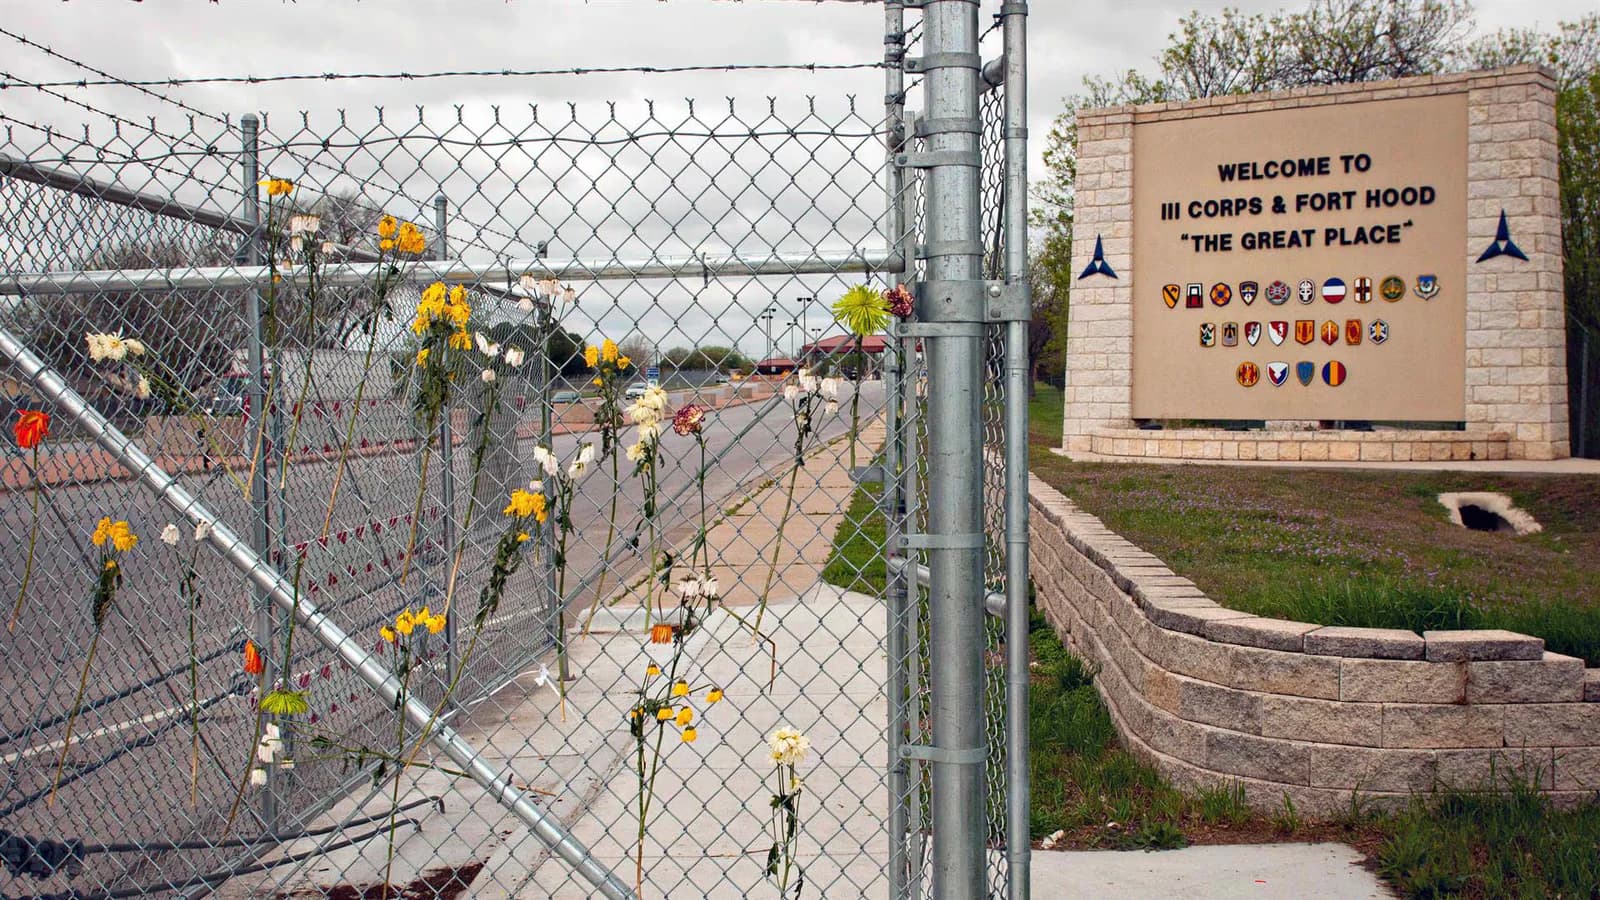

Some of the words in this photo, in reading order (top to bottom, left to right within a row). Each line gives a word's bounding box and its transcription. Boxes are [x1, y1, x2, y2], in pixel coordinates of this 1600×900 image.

[1217, 157, 1331, 182] WELCOME
[1339, 153, 1372, 175] TO
[1161, 202, 1181, 221] III
[1187, 197, 1263, 219] CORPS
[1271, 195, 1287, 215] &
[1295, 190, 1357, 213] FORT
[1365, 185, 1437, 209] HOOD
[1240, 228, 1317, 251] GREAT
